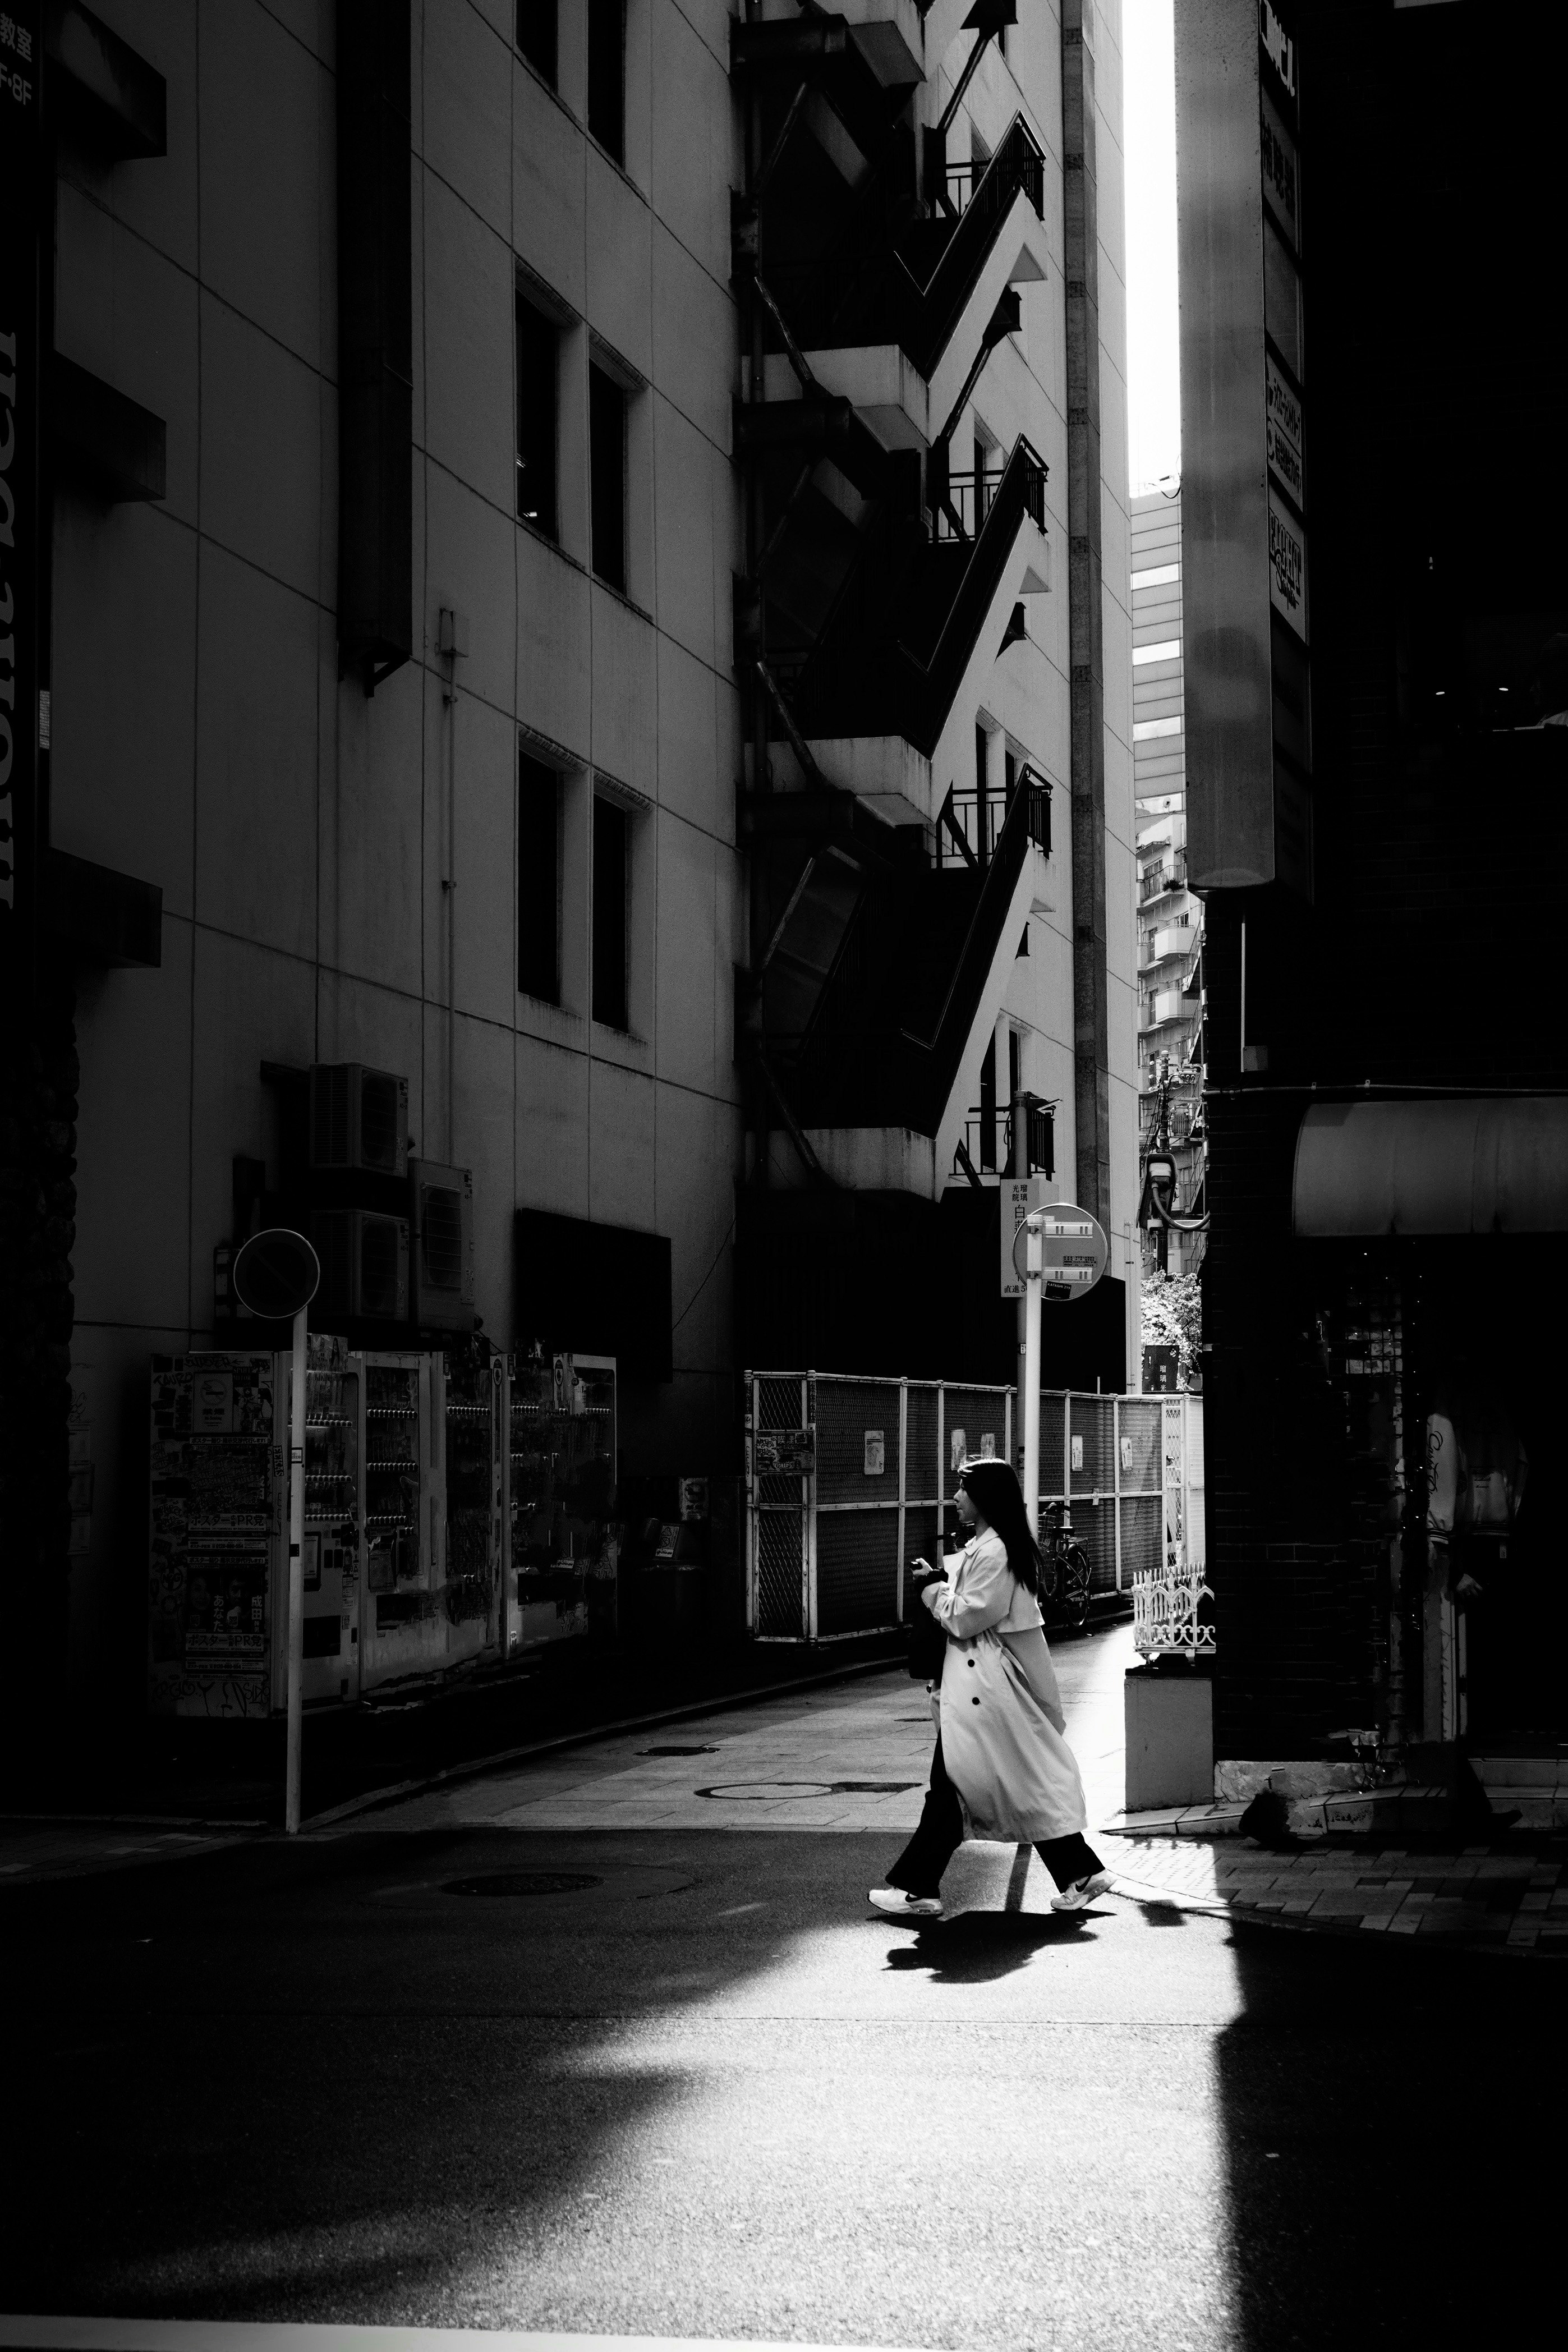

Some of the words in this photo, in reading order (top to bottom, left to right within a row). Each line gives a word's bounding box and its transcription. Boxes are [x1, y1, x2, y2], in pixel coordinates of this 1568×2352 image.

[1012, 1184, 1019, 1202] 光院
[1020, 1184, 1028, 1202] 瑠璃
[213, 1595, 224, 1632] あなた
